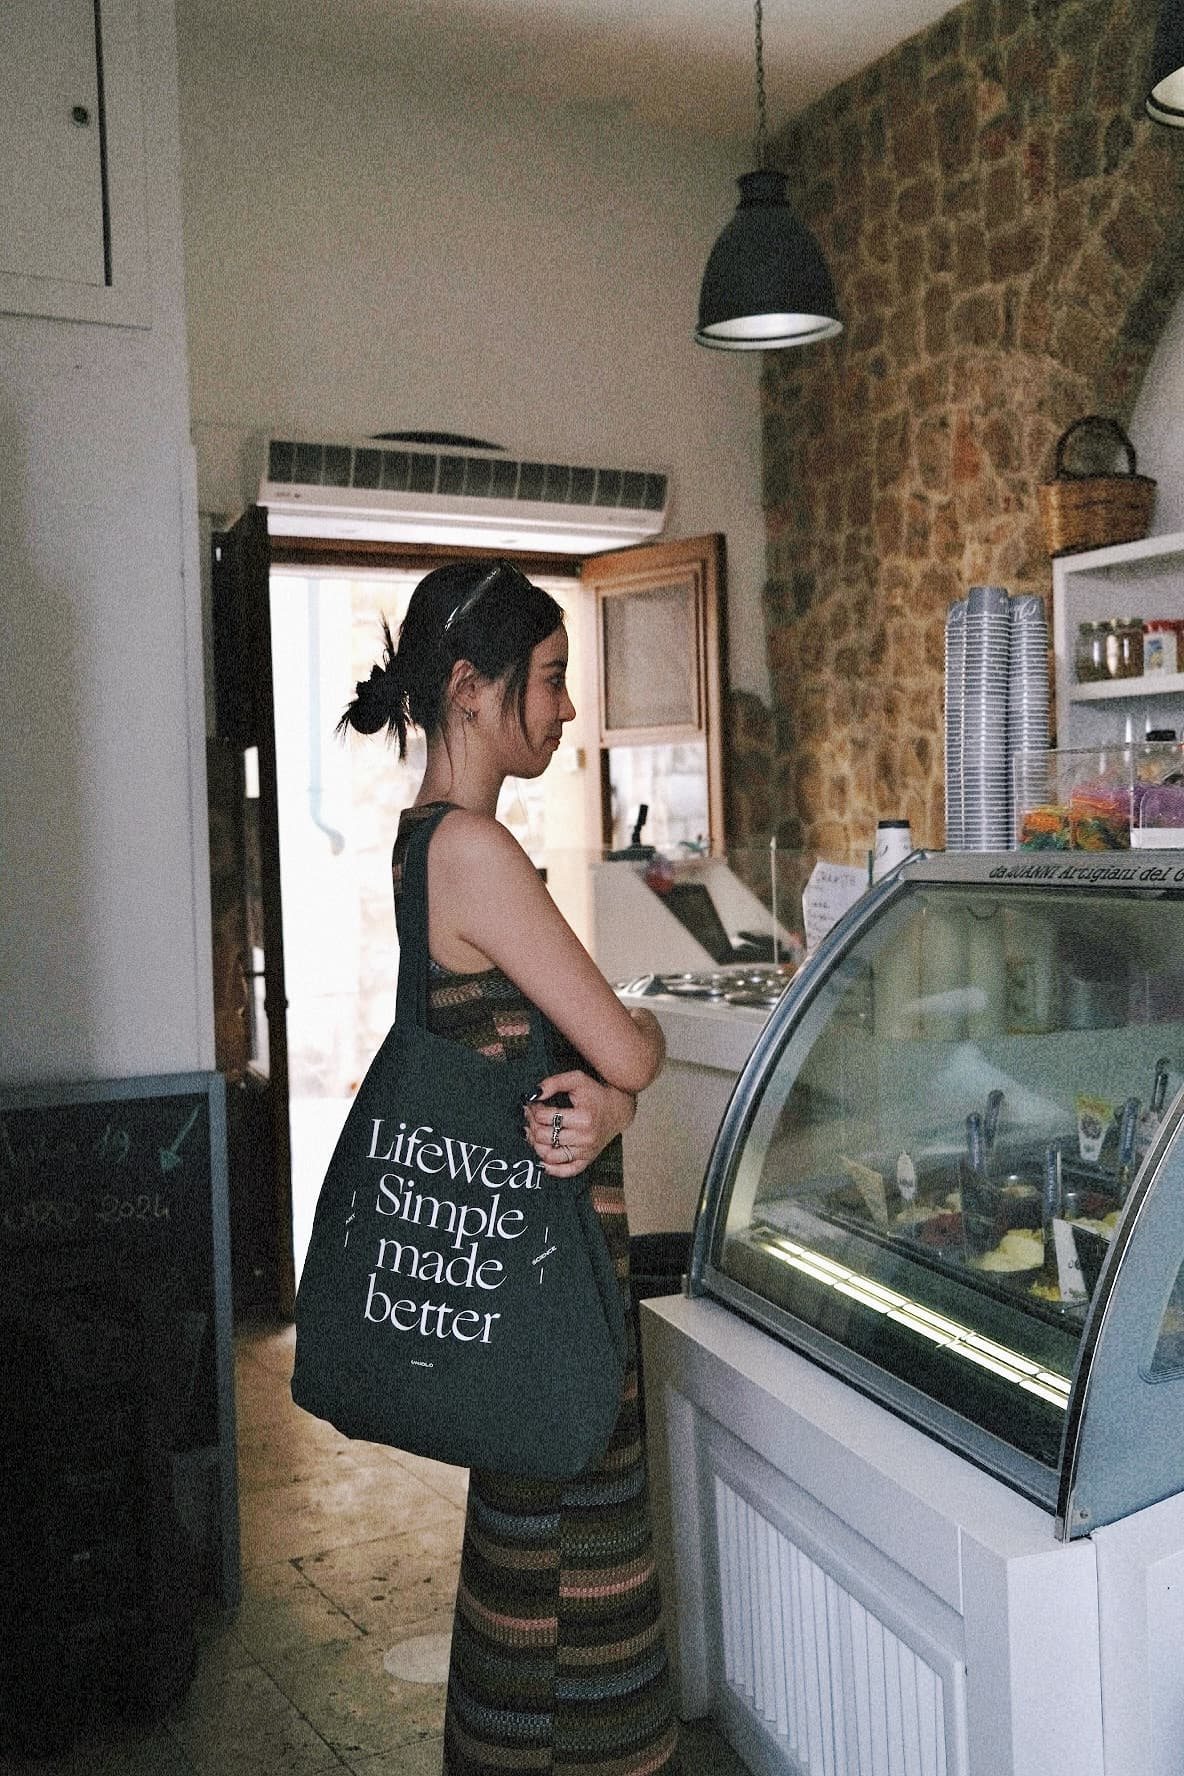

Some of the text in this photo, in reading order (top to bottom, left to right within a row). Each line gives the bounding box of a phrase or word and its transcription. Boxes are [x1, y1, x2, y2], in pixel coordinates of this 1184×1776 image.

[375, 1173, 529, 1250] Simple
[375, 1238, 508, 1290] made
[363, 1272, 501, 1344] better
